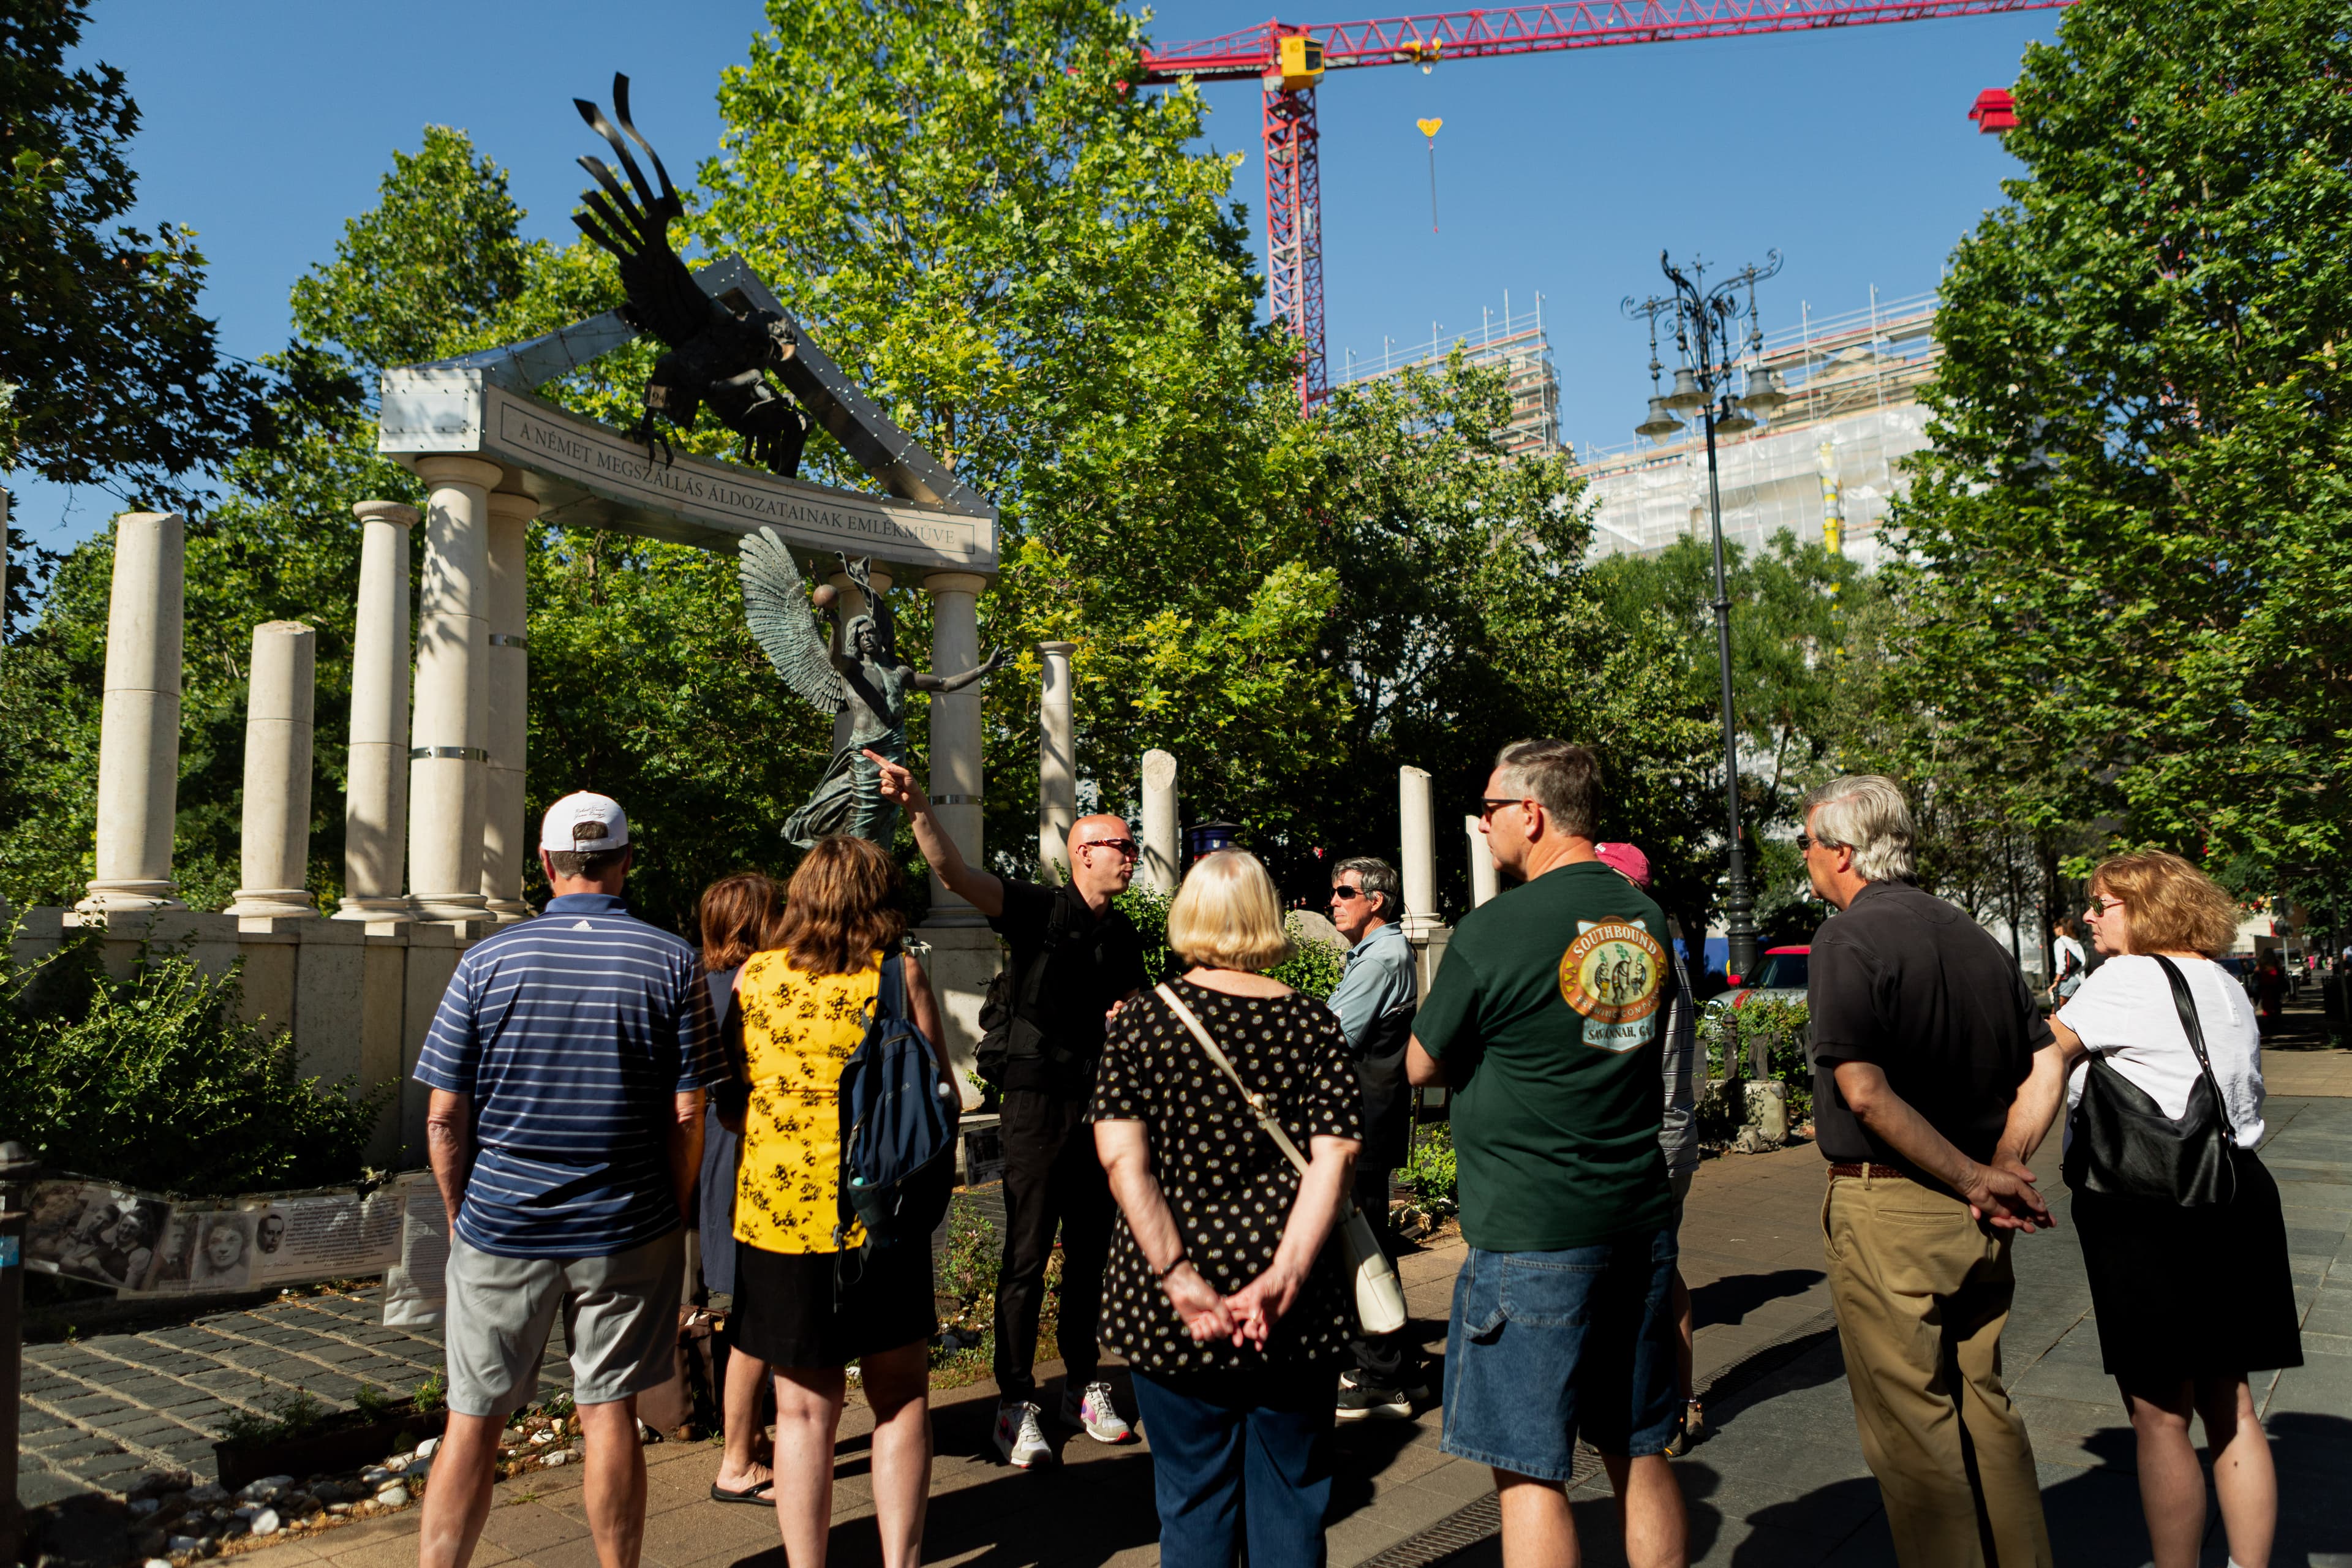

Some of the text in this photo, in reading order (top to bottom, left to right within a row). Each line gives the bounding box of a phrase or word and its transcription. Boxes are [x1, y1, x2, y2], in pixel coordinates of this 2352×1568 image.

[521, 423, 955, 545] A NÉMET MEGSZÁLLÁS ÁLDOZATAINAK EMLÉKMŰVE
[1573, 925, 1657, 959] SOUTHBOUND
[1576, 989, 1660, 1019] BREWING COMPANY
[1588, 1025, 1651, 1041] SAVANNAH, GA
